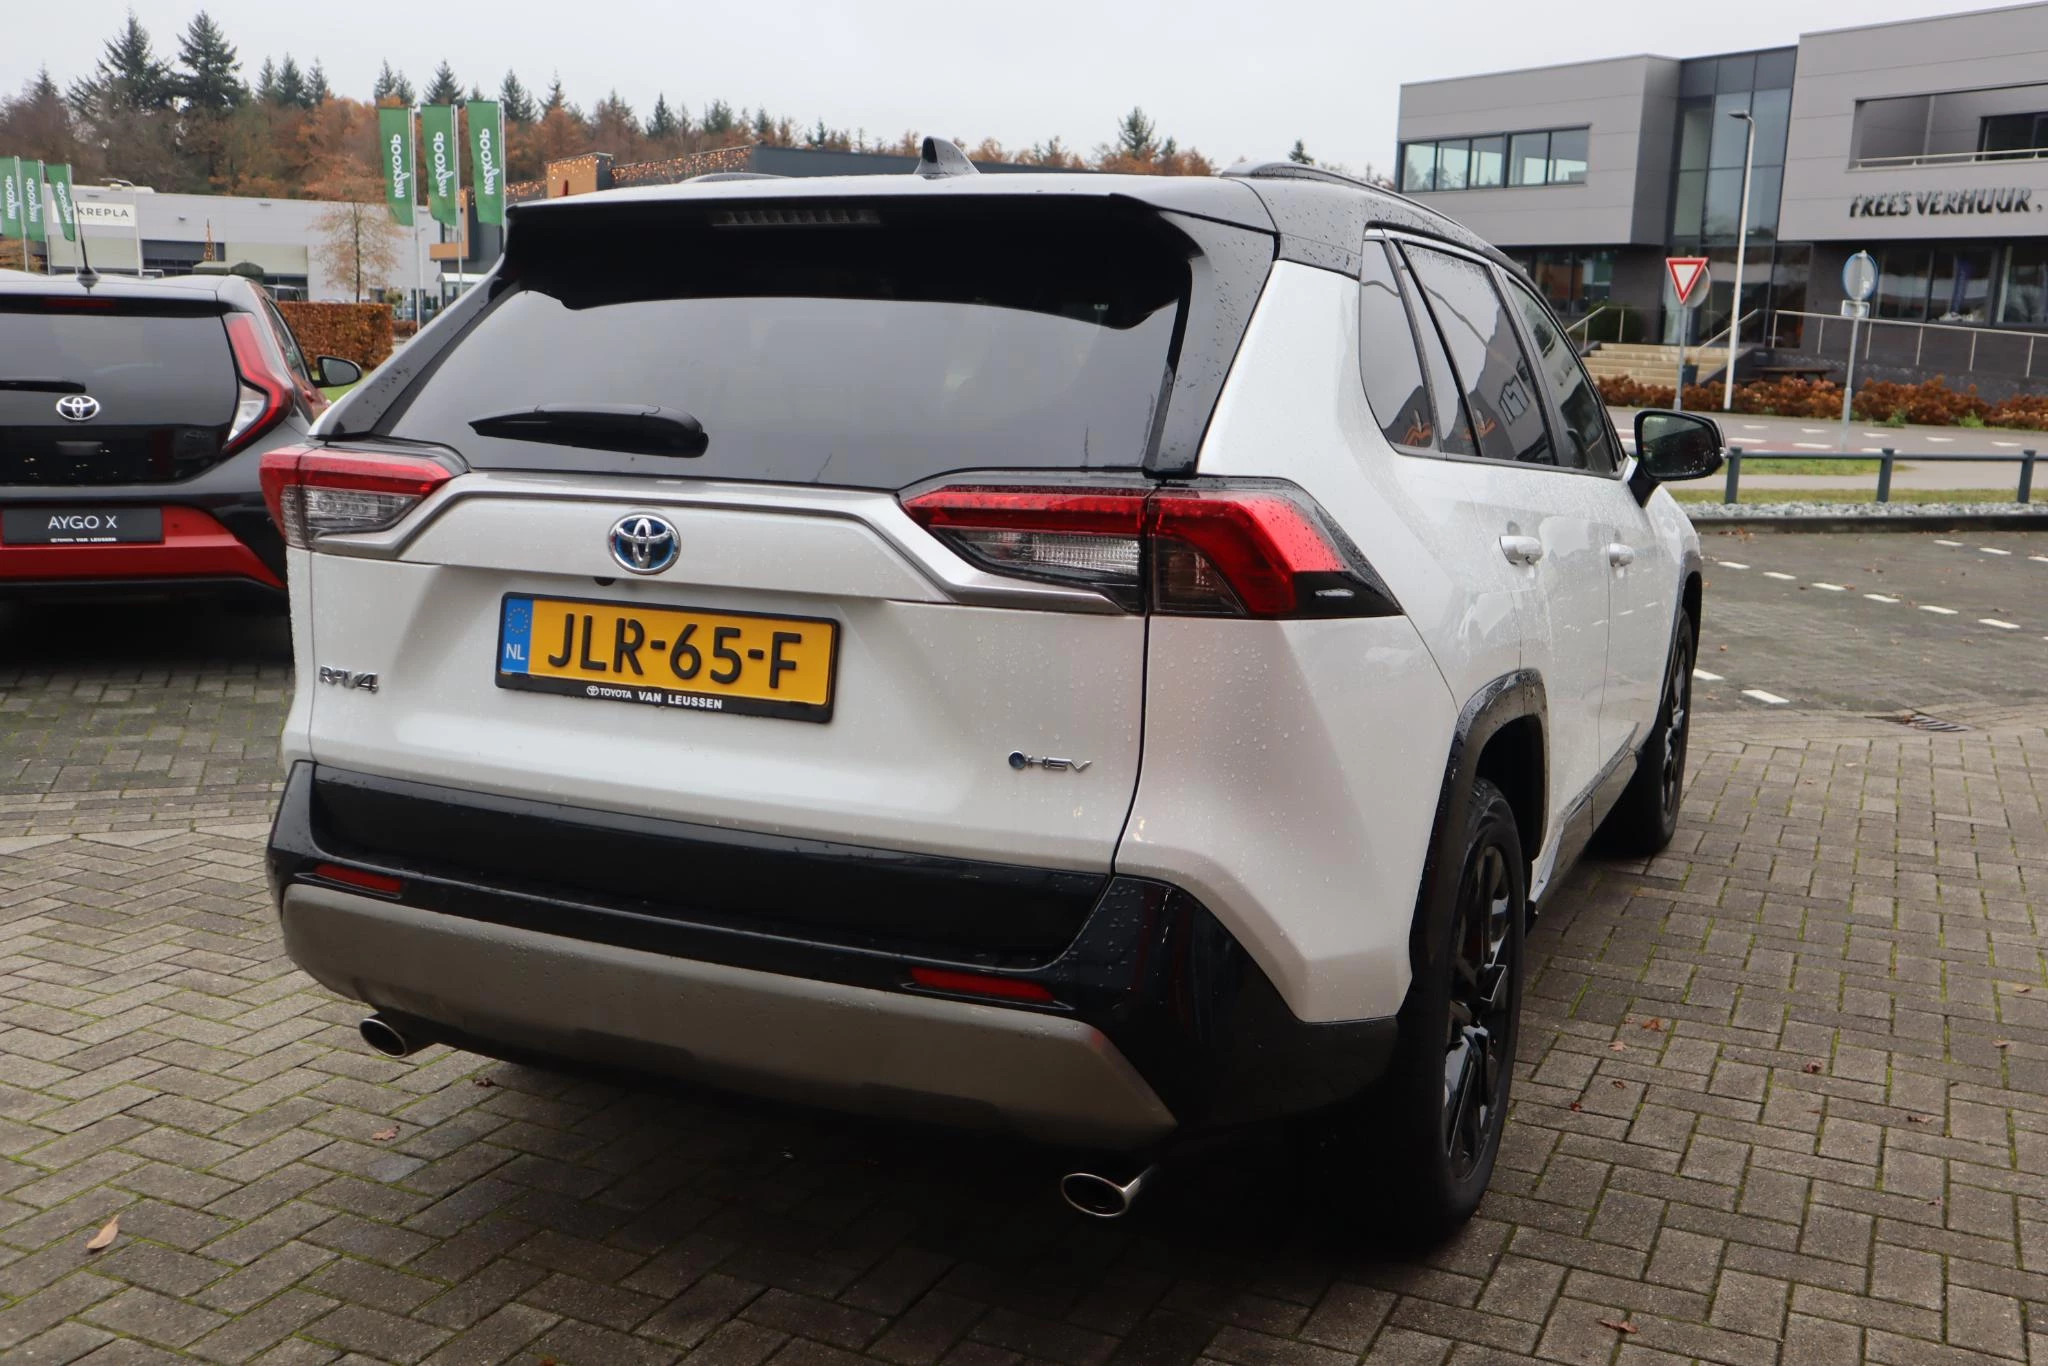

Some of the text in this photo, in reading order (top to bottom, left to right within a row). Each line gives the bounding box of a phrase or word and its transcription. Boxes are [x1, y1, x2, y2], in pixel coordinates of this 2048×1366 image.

[48, 515, 117, 529] AYGO X
[506, 643, 525, 661] NL
[548, 613, 802, 689] JLR-65-F
[600, 687, 722, 709] TOYOTA VAN LEUSSEN
